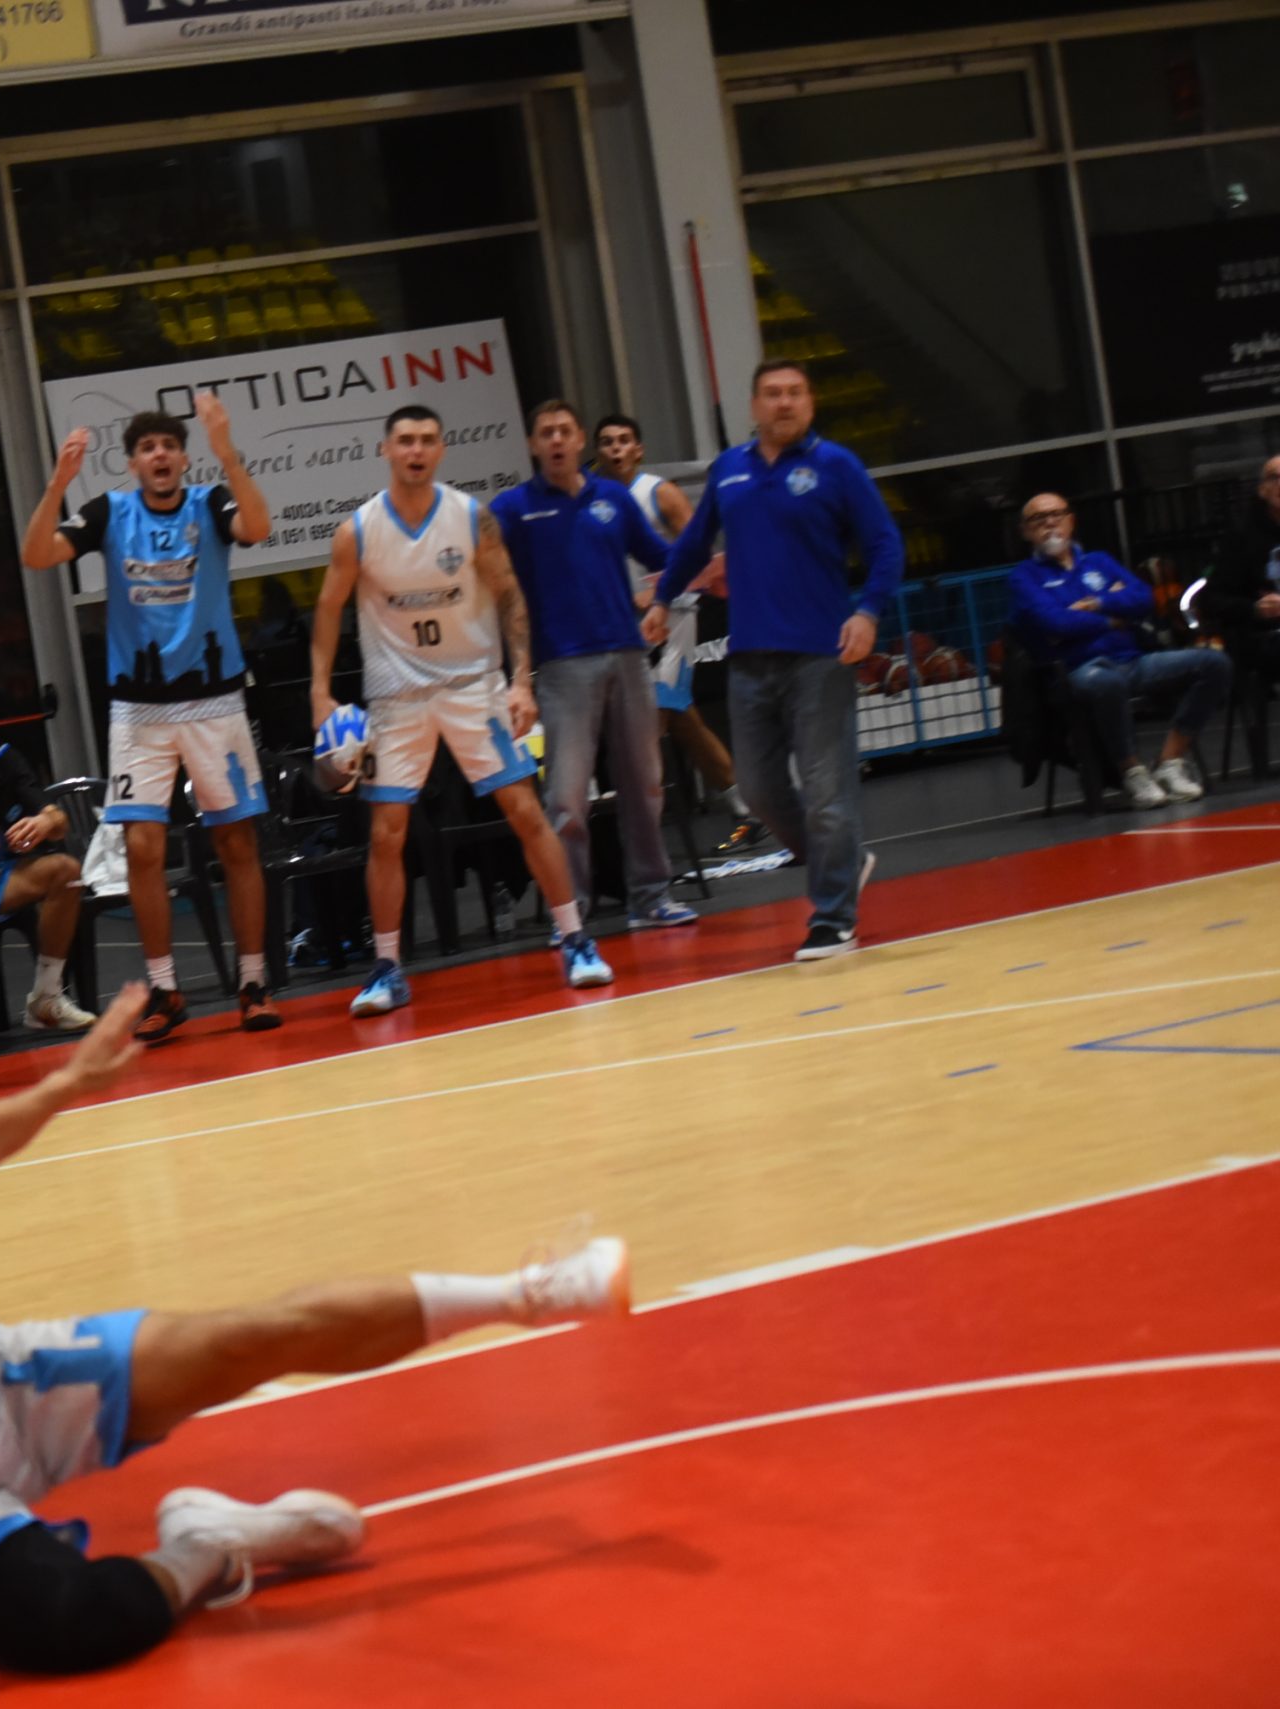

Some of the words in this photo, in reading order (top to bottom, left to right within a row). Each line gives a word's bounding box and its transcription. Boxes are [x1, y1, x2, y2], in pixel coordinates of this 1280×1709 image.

[150, 530, 174, 552] 12
[412, 618, 442, 648] 10
[112, 773, 135, 801] 12
